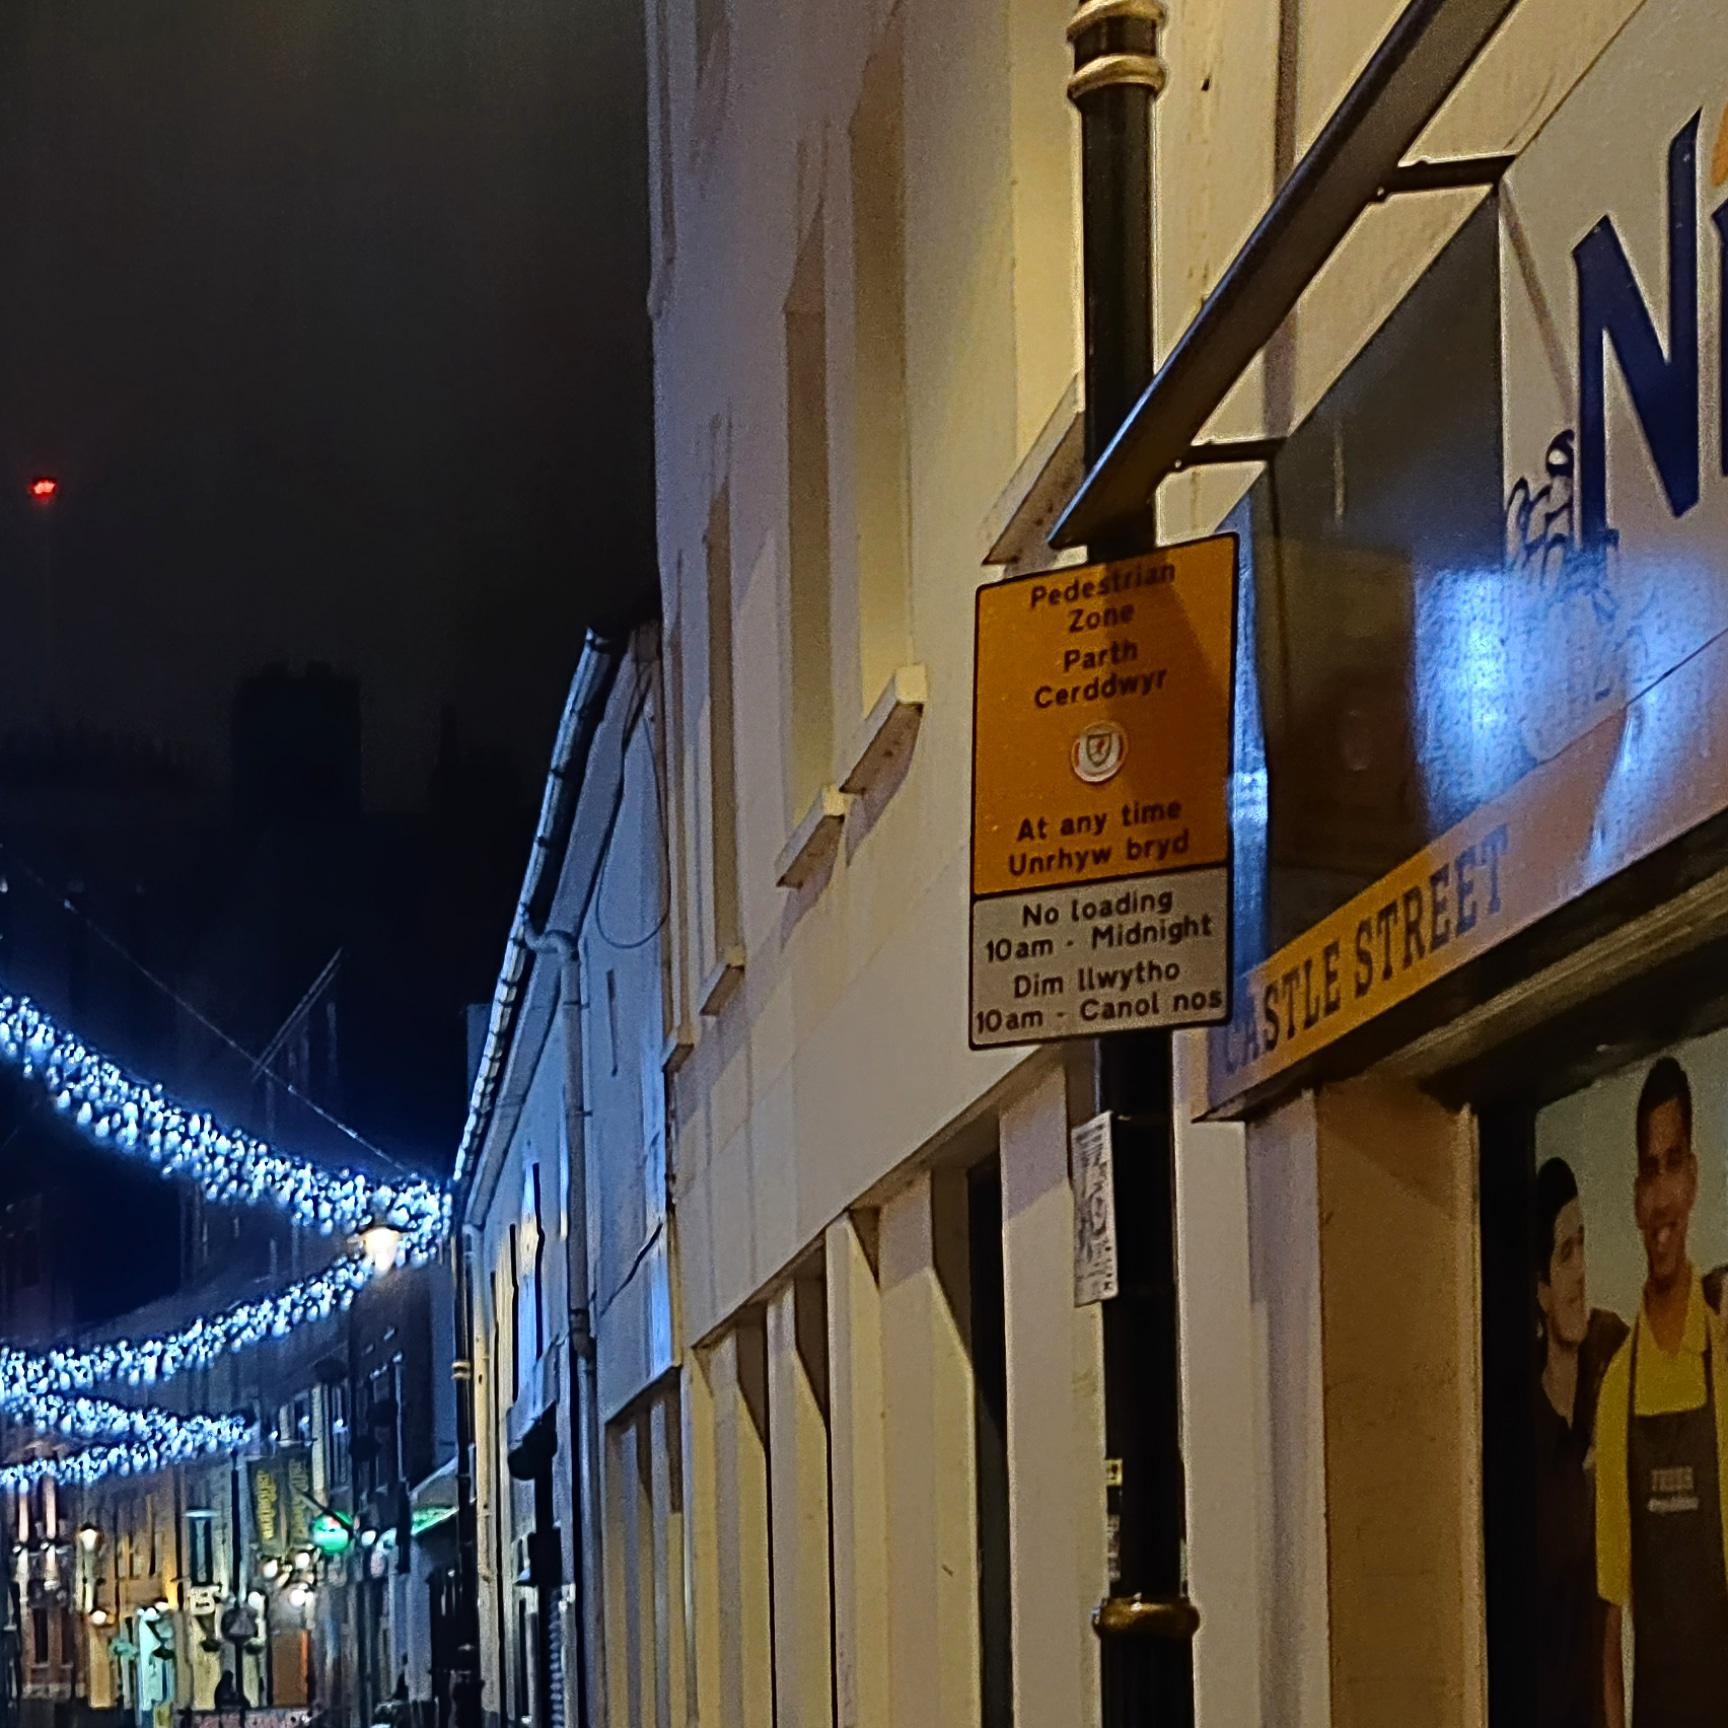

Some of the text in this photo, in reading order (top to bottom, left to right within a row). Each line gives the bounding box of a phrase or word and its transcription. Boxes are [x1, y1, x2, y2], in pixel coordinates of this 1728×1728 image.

[1574, 107, 1728, 518] N
[1031, 564, 1175, 608] Pedestrian
[1069, 604, 1134, 633] Zone
[1064, 640, 1137, 672] Parth
[1035, 669, 1167, 708] Cerddwyr
[1017, 801, 1181, 841] At any time
[1009, 829, 1189, 876] Unrhyw bryd
[1023, 891, 1173, 928] No loading
[1355, 824, 1508, 999] STREET
[986, 938, 1054, 963] 10am
[1092, 914, 1213, 950] Midnight
[1014, 959, 1180, 999] Dim llwytho
[977, 1000, 1043, 1035] 10am
[1080, 992, 1160, 1022] Canol
[1173, 990, 1222, 1013] nos
